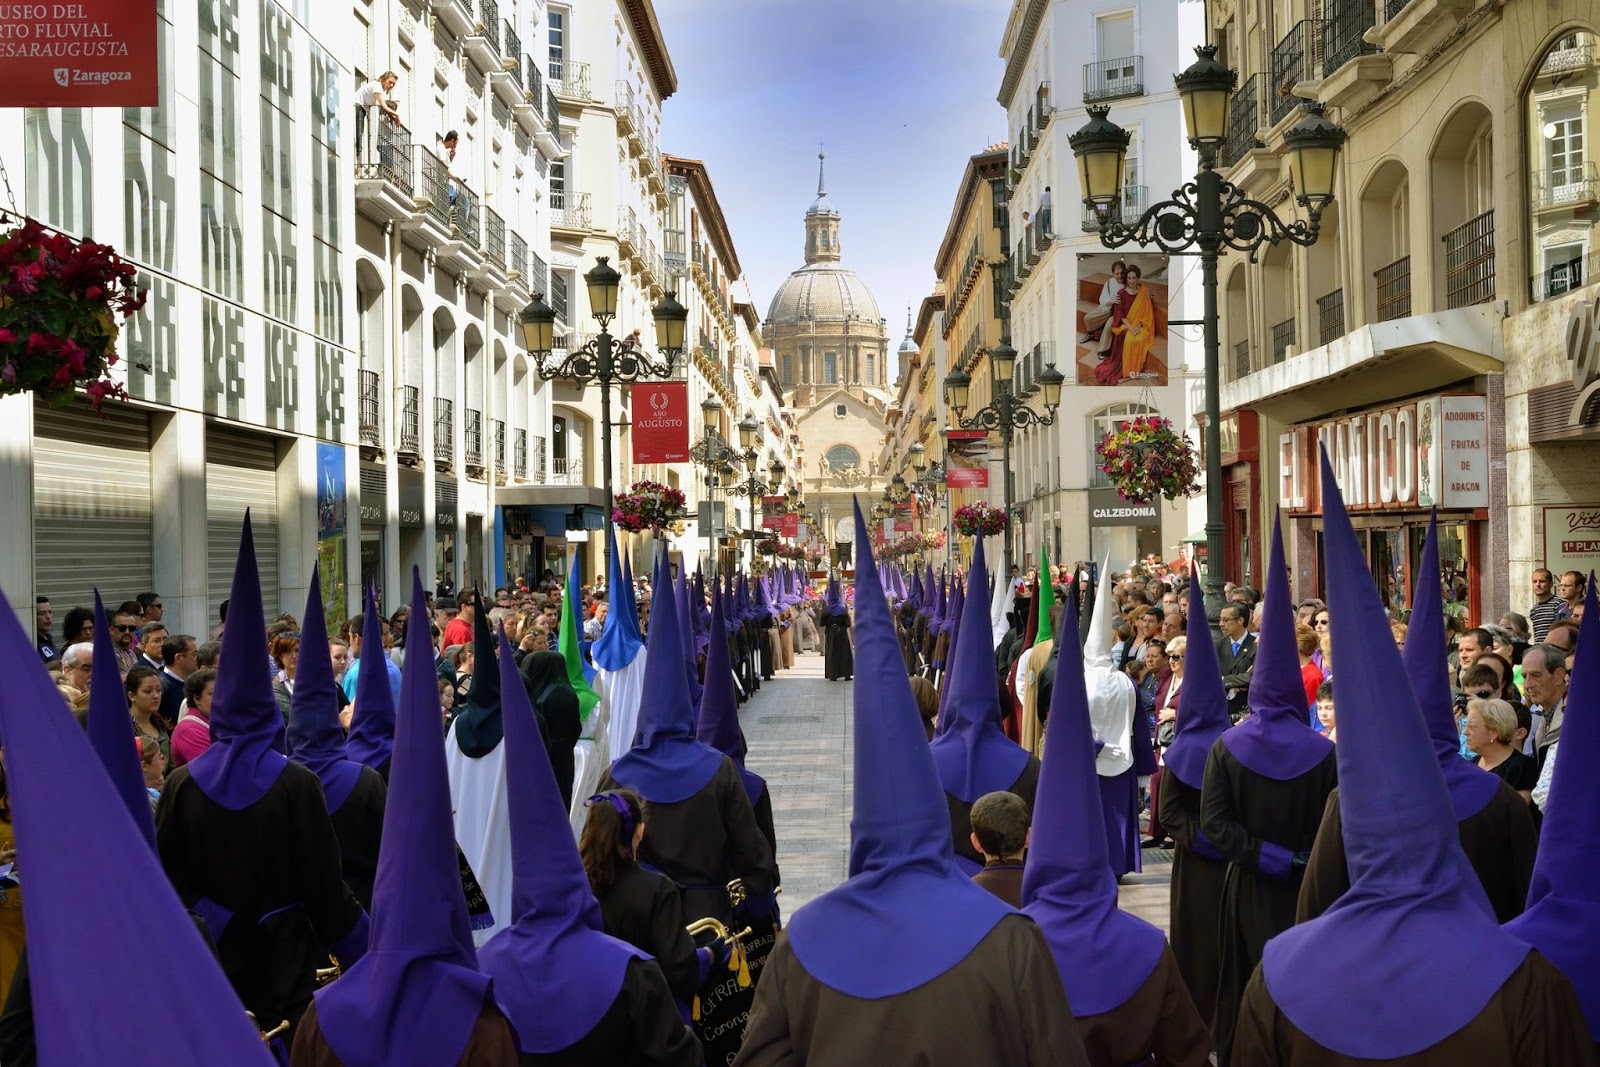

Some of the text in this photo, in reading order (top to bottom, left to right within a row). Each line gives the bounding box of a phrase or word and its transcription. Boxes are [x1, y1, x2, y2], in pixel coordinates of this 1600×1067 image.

[0, 4, 87, 19] USEO DEL
[35, 23, 113, 38] FLUVIAL
[0, 42, 129, 57] ESARAUGUSTA
[73, 69, 131, 85] Zaragoza
[1135, 371, 1159, 379] Zaragoza
[1445, 411, 1485, 421] ADOQUINES
[638, 419, 683, 428] AUGUSTO
[1451, 440, 1480, 449] FRUTAS
[1280, 431, 1306, 508] EL
[1461, 461, 1471, 470] DE
[1451, 482, 1480, 491] ARAGON
[1093, 507, 1157, 518] CALZEDONIA
[1566, 511, 1600, 528] Vik
[704, 1010, 752, 1041] Corona
